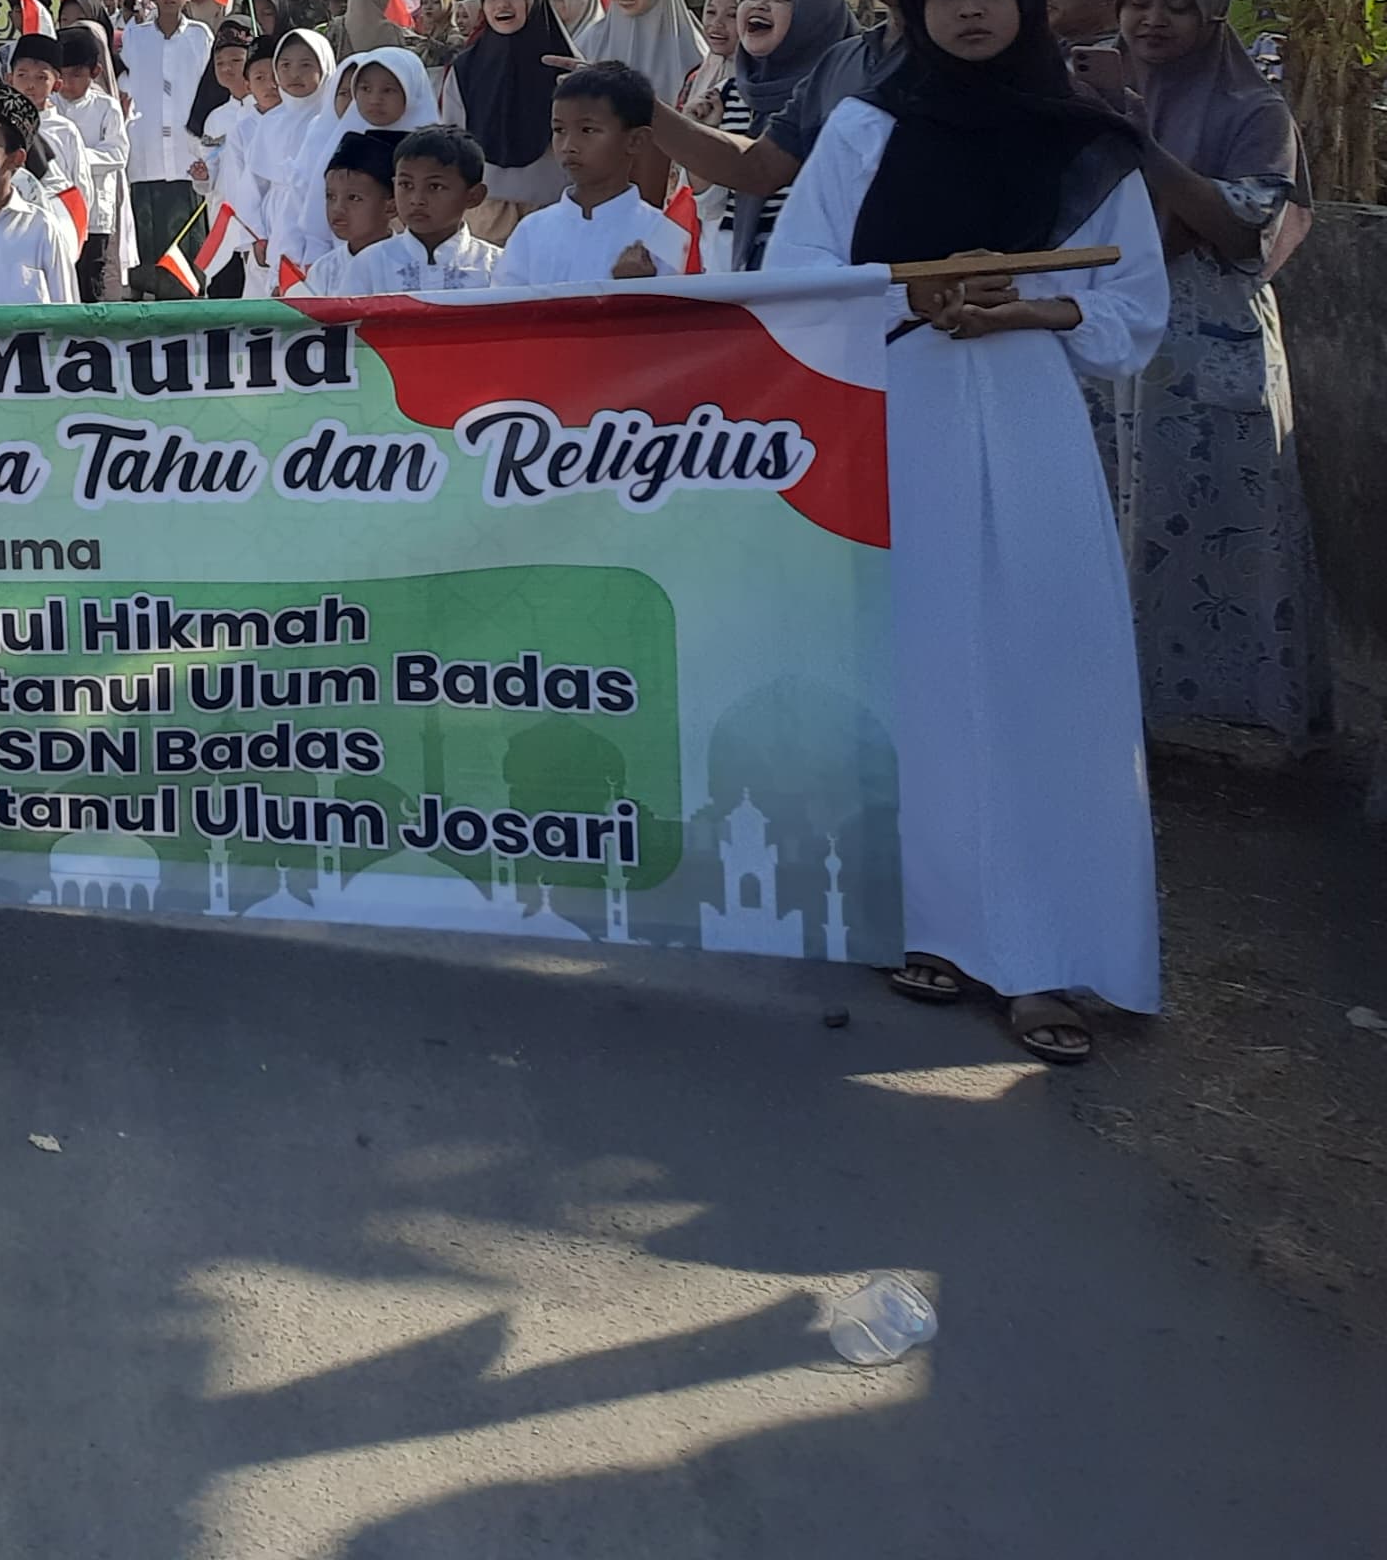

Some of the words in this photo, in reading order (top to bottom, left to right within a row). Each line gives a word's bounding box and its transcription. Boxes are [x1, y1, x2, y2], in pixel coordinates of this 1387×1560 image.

[66, 423, 257, 501] Tahu
[283, 429, 438, 493] dan
[466, 407, 805, 502] Religius
[82, 594, 367, 652] Hikmah
[191, 663, 376, 712] Ulum
[396, 652, 637, 715] Badas
[156, 723, 383, 775] Badas
[194, 785, 385, 850] Ulum
[404, 795, 640, 866] Josari
